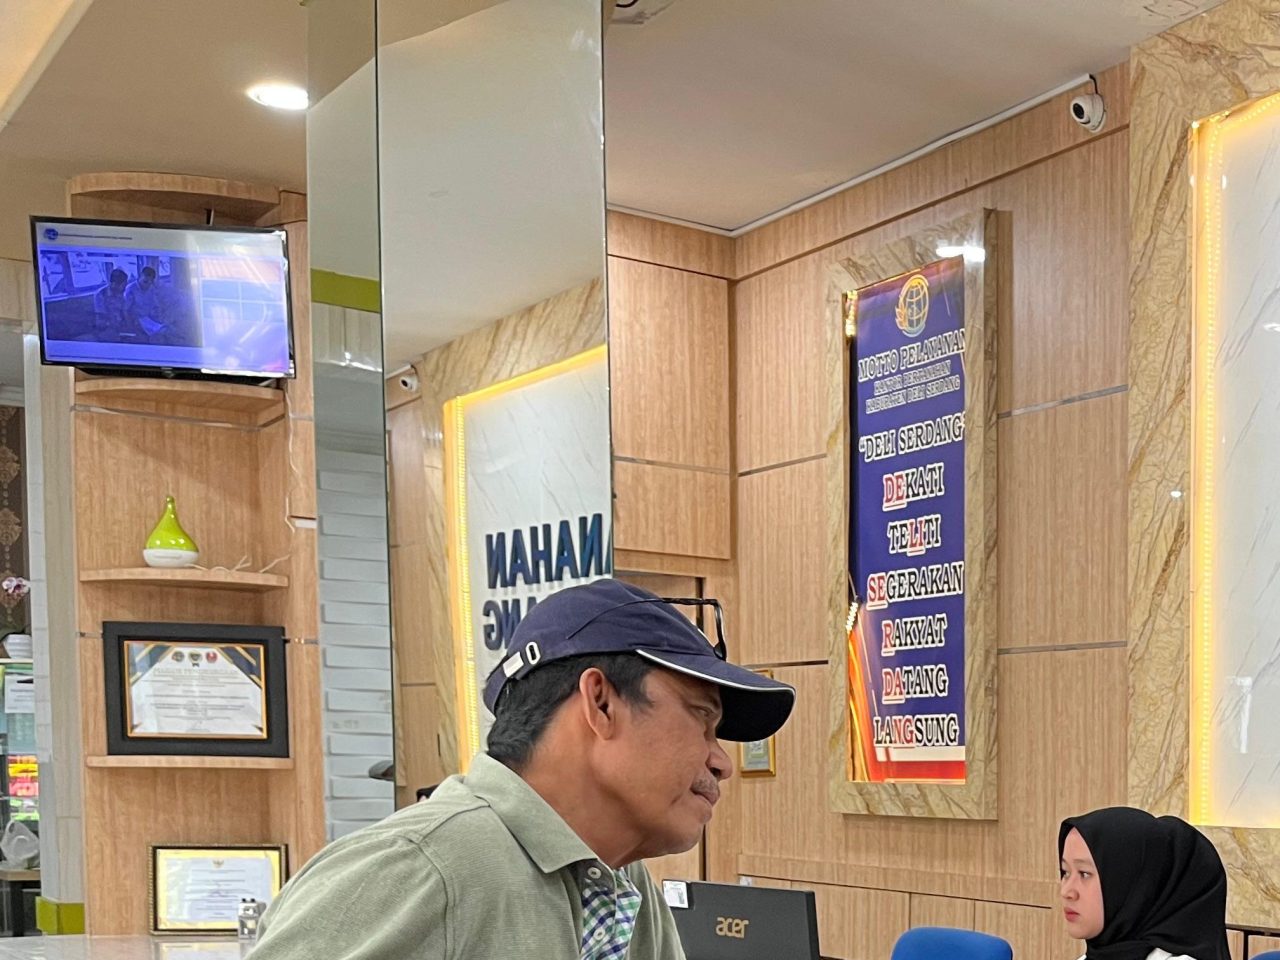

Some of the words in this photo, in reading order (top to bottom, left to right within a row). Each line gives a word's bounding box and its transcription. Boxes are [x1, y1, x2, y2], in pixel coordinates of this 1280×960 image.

[858, 349, 899, 382] MOTTO
[883, 463, 944, 506] DEKATI
[887, 514, 941, 553] TELITI
[867, 561, 964, 606] SEGERAKAN
[882, 614, 946, 652] RAKYAT
[882, 664, 948, 701] DATANG
[873, 713, 959, 748] LANGSUNG
[715, 917, 749, 939] acer
